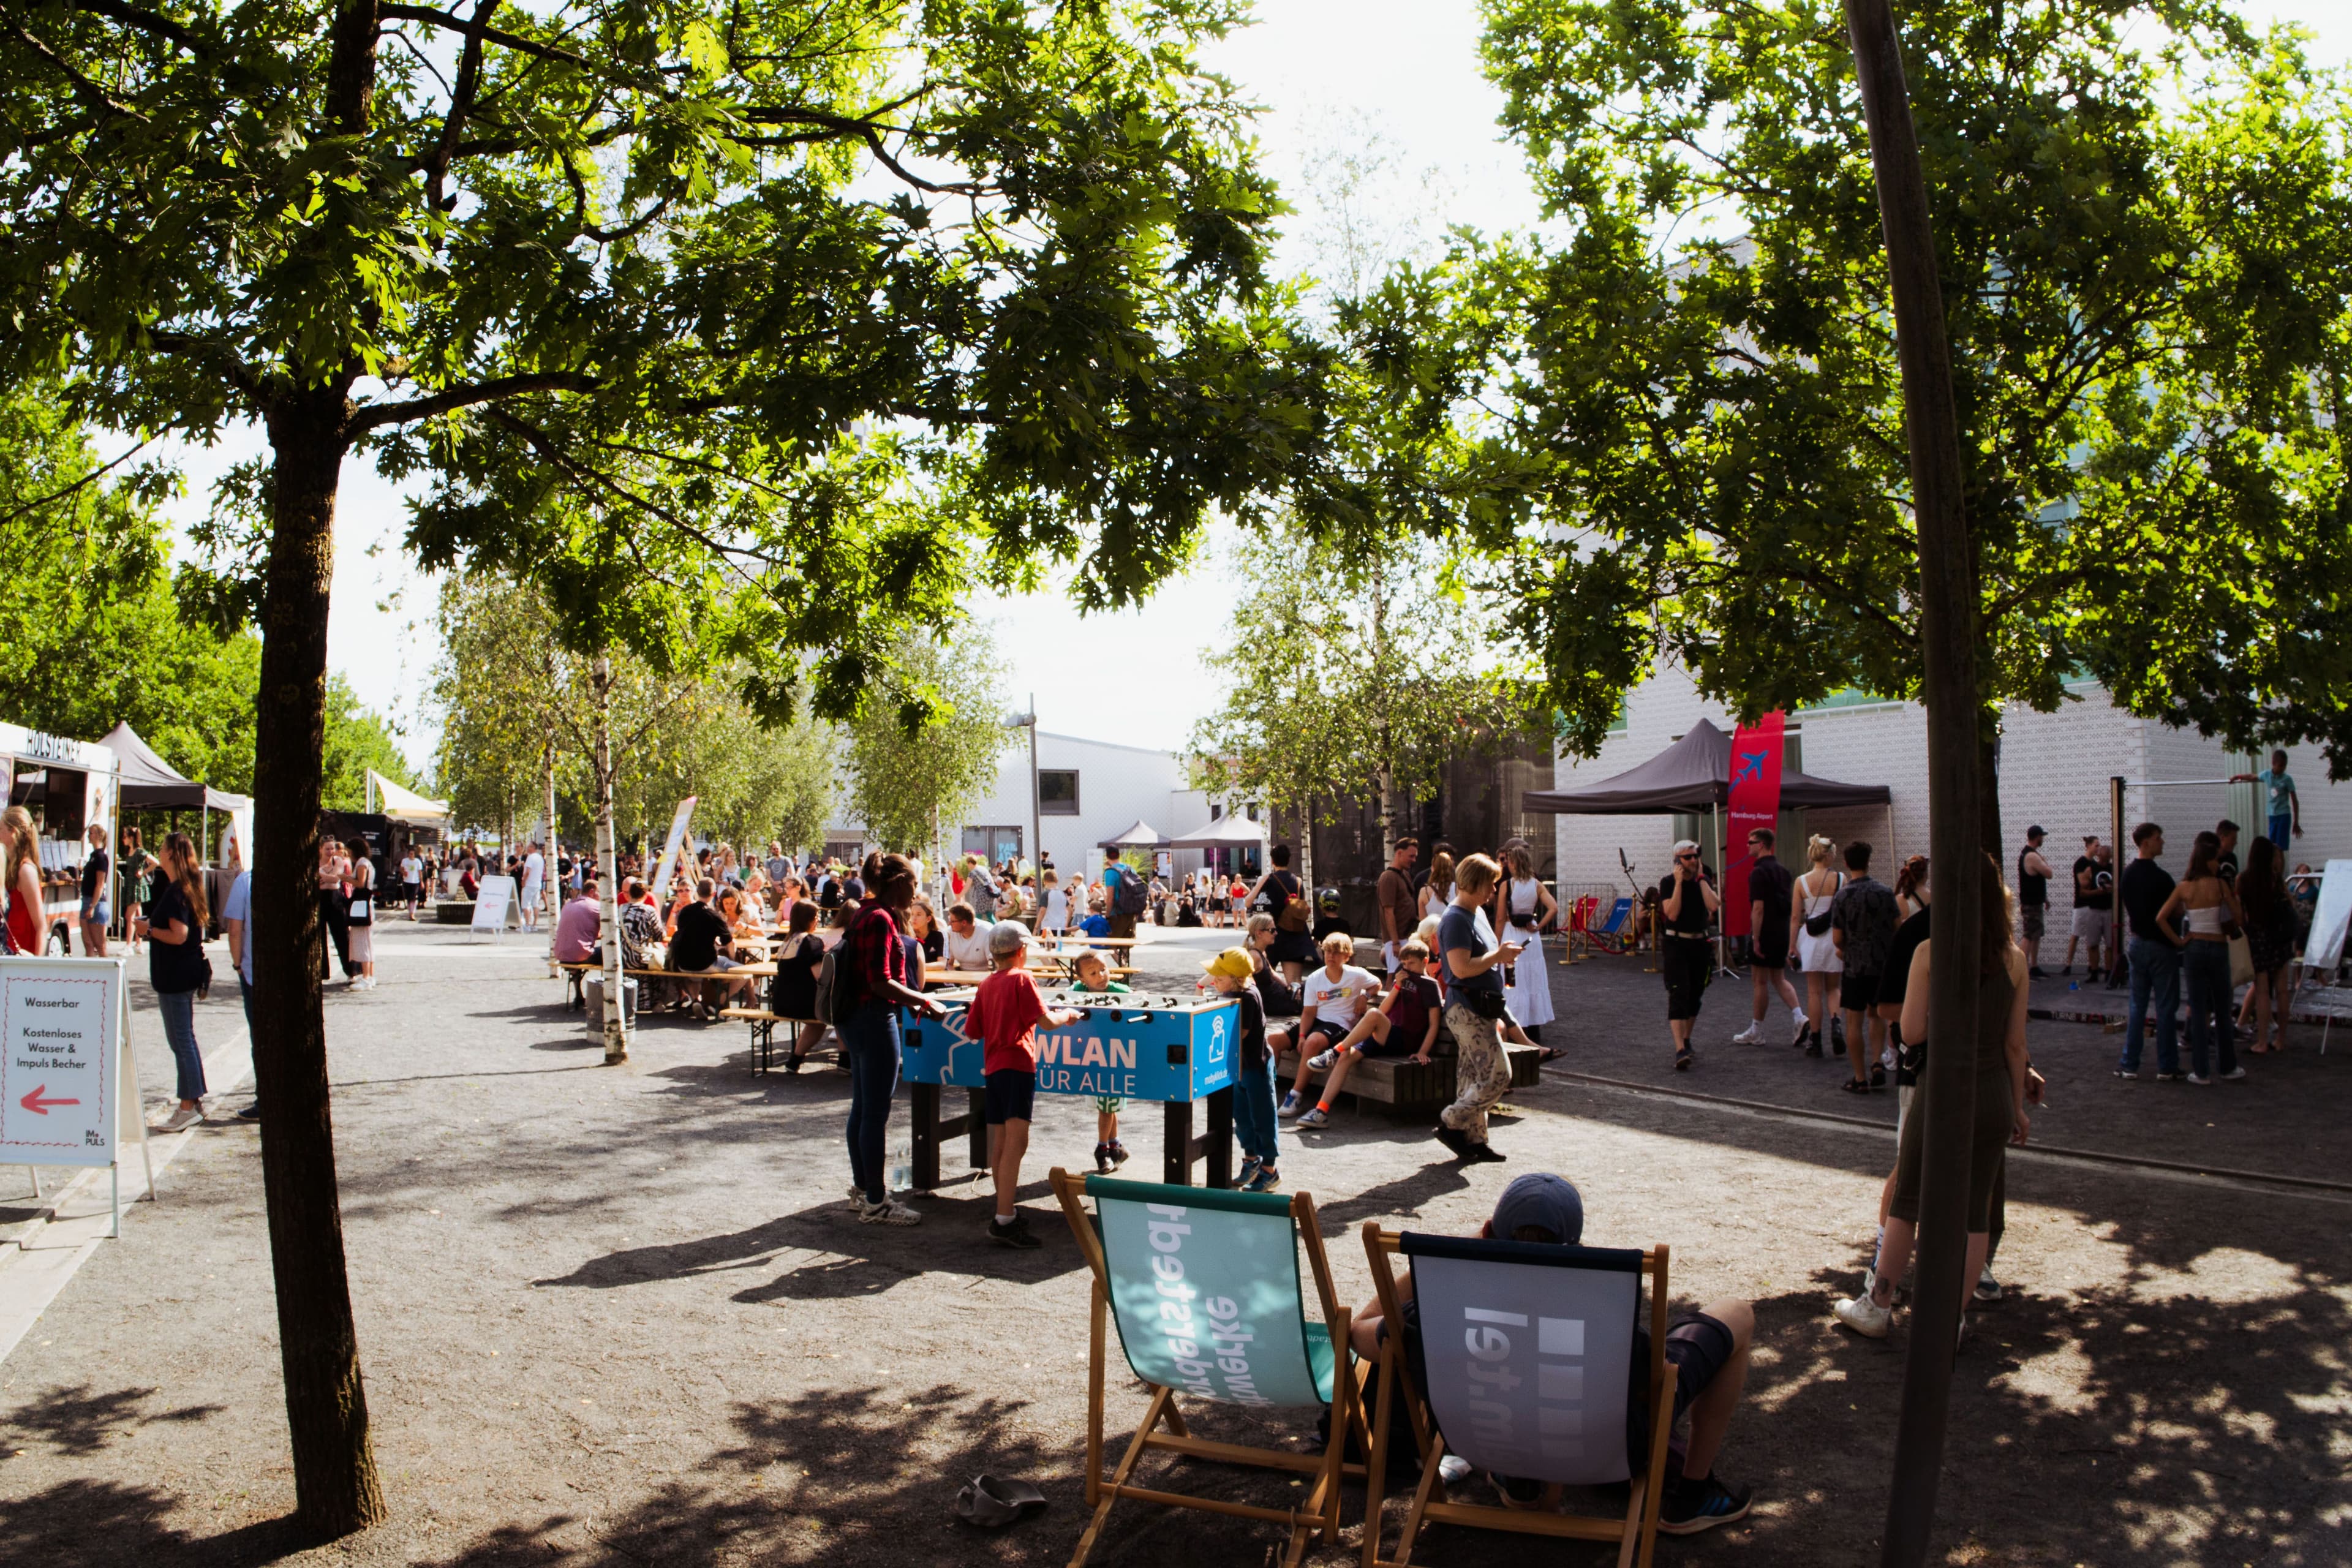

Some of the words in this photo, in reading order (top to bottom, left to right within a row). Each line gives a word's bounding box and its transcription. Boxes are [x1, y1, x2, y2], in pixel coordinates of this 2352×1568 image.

[27, 729, 83, 764] HOLSTEINER
[1731, 811, 1756, 820] Hamburg
[24, 997, 80, 1008] Wasserbar
[23, 1027, 82, 1039] Kostenloses
[28, 1042, 65, 1053] Wasser
[67, 1043, 76, 1054] &
[1035, 1033, 1137, 1069] WLAN
[17, 1057, 50, 1070] Impuls
[51, 1058, 86, 1069] Becher
[1035, 1065, 1071, 1090] ÜR
[1079, 1072, 1136, 1095] ALLE
